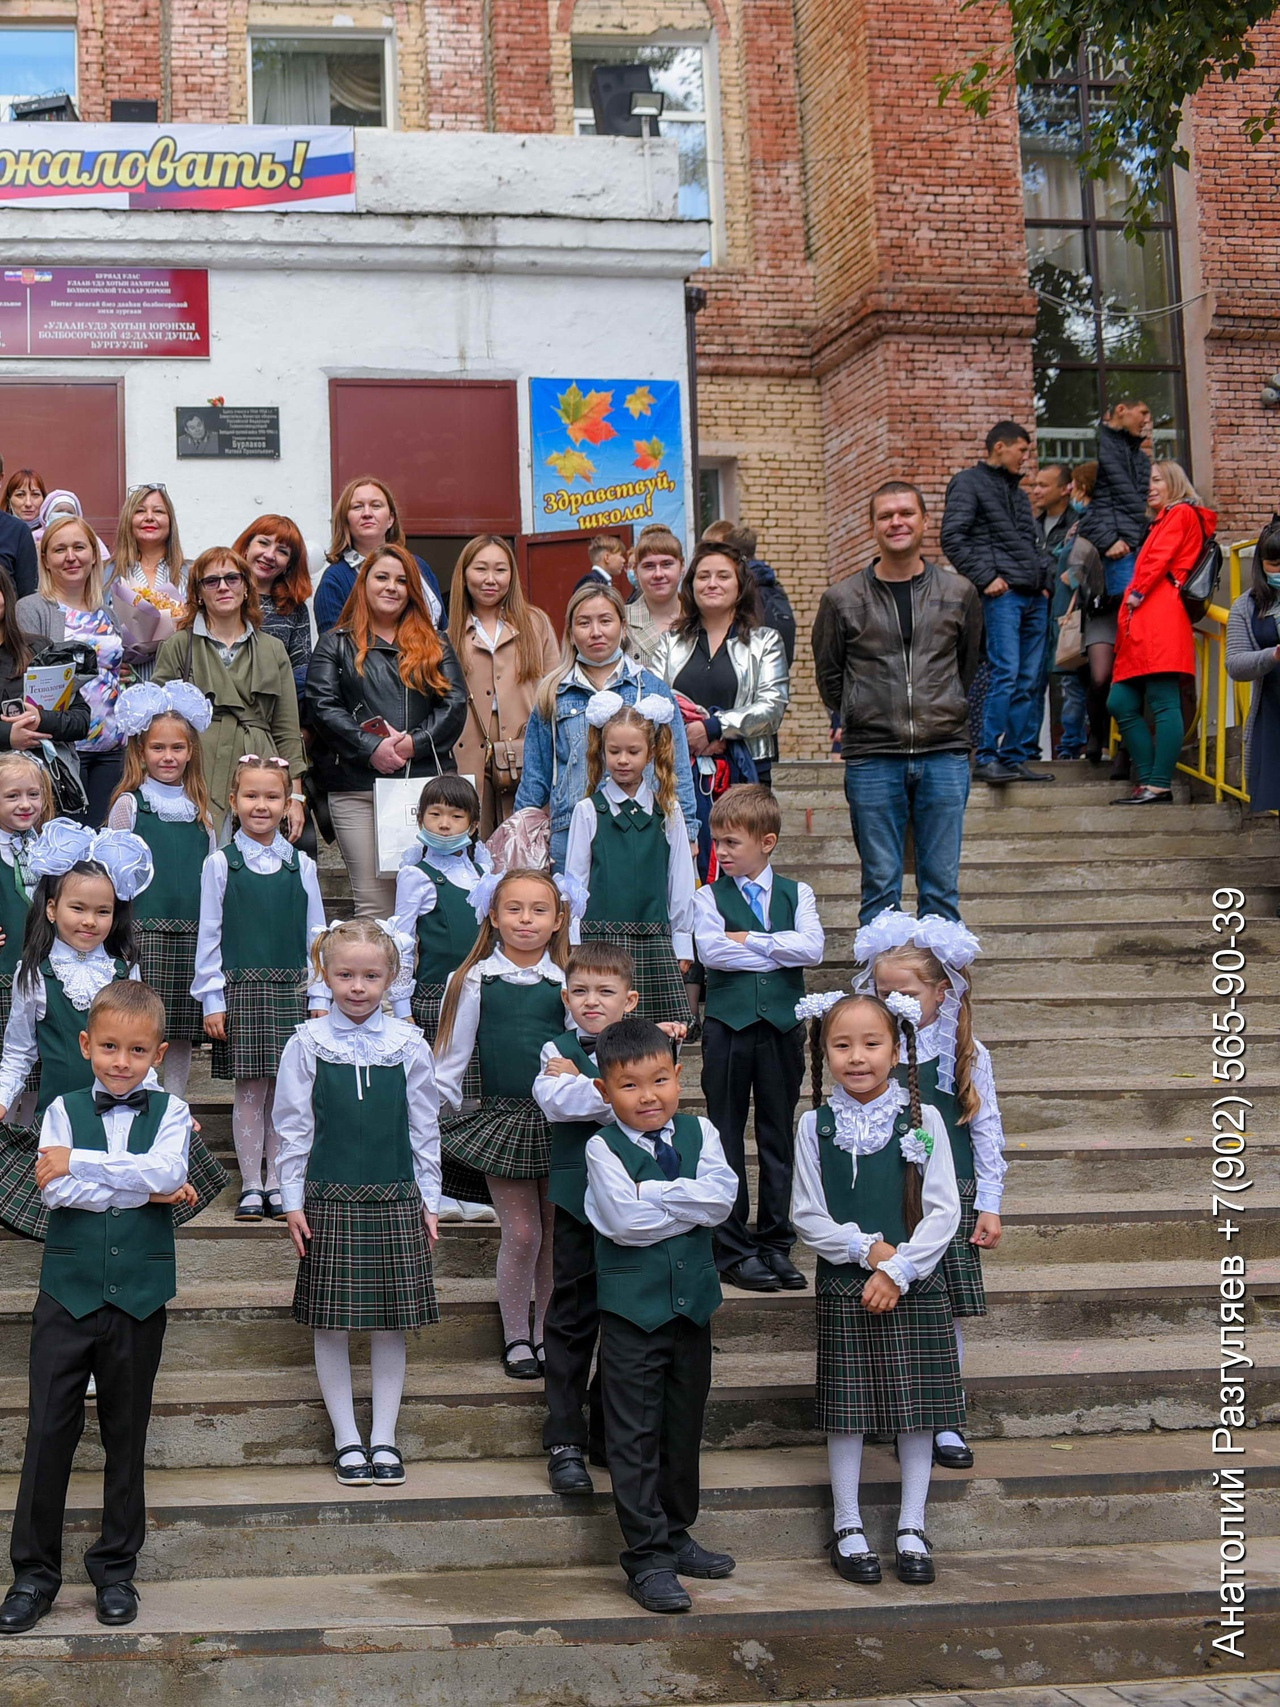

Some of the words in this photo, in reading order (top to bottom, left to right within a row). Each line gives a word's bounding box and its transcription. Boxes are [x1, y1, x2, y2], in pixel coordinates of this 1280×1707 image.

[232, 440, 266, 449] Бурлаков
[544, 471, 675, 514] Здравствуй,
[578, 495, 653, 529] школа!
